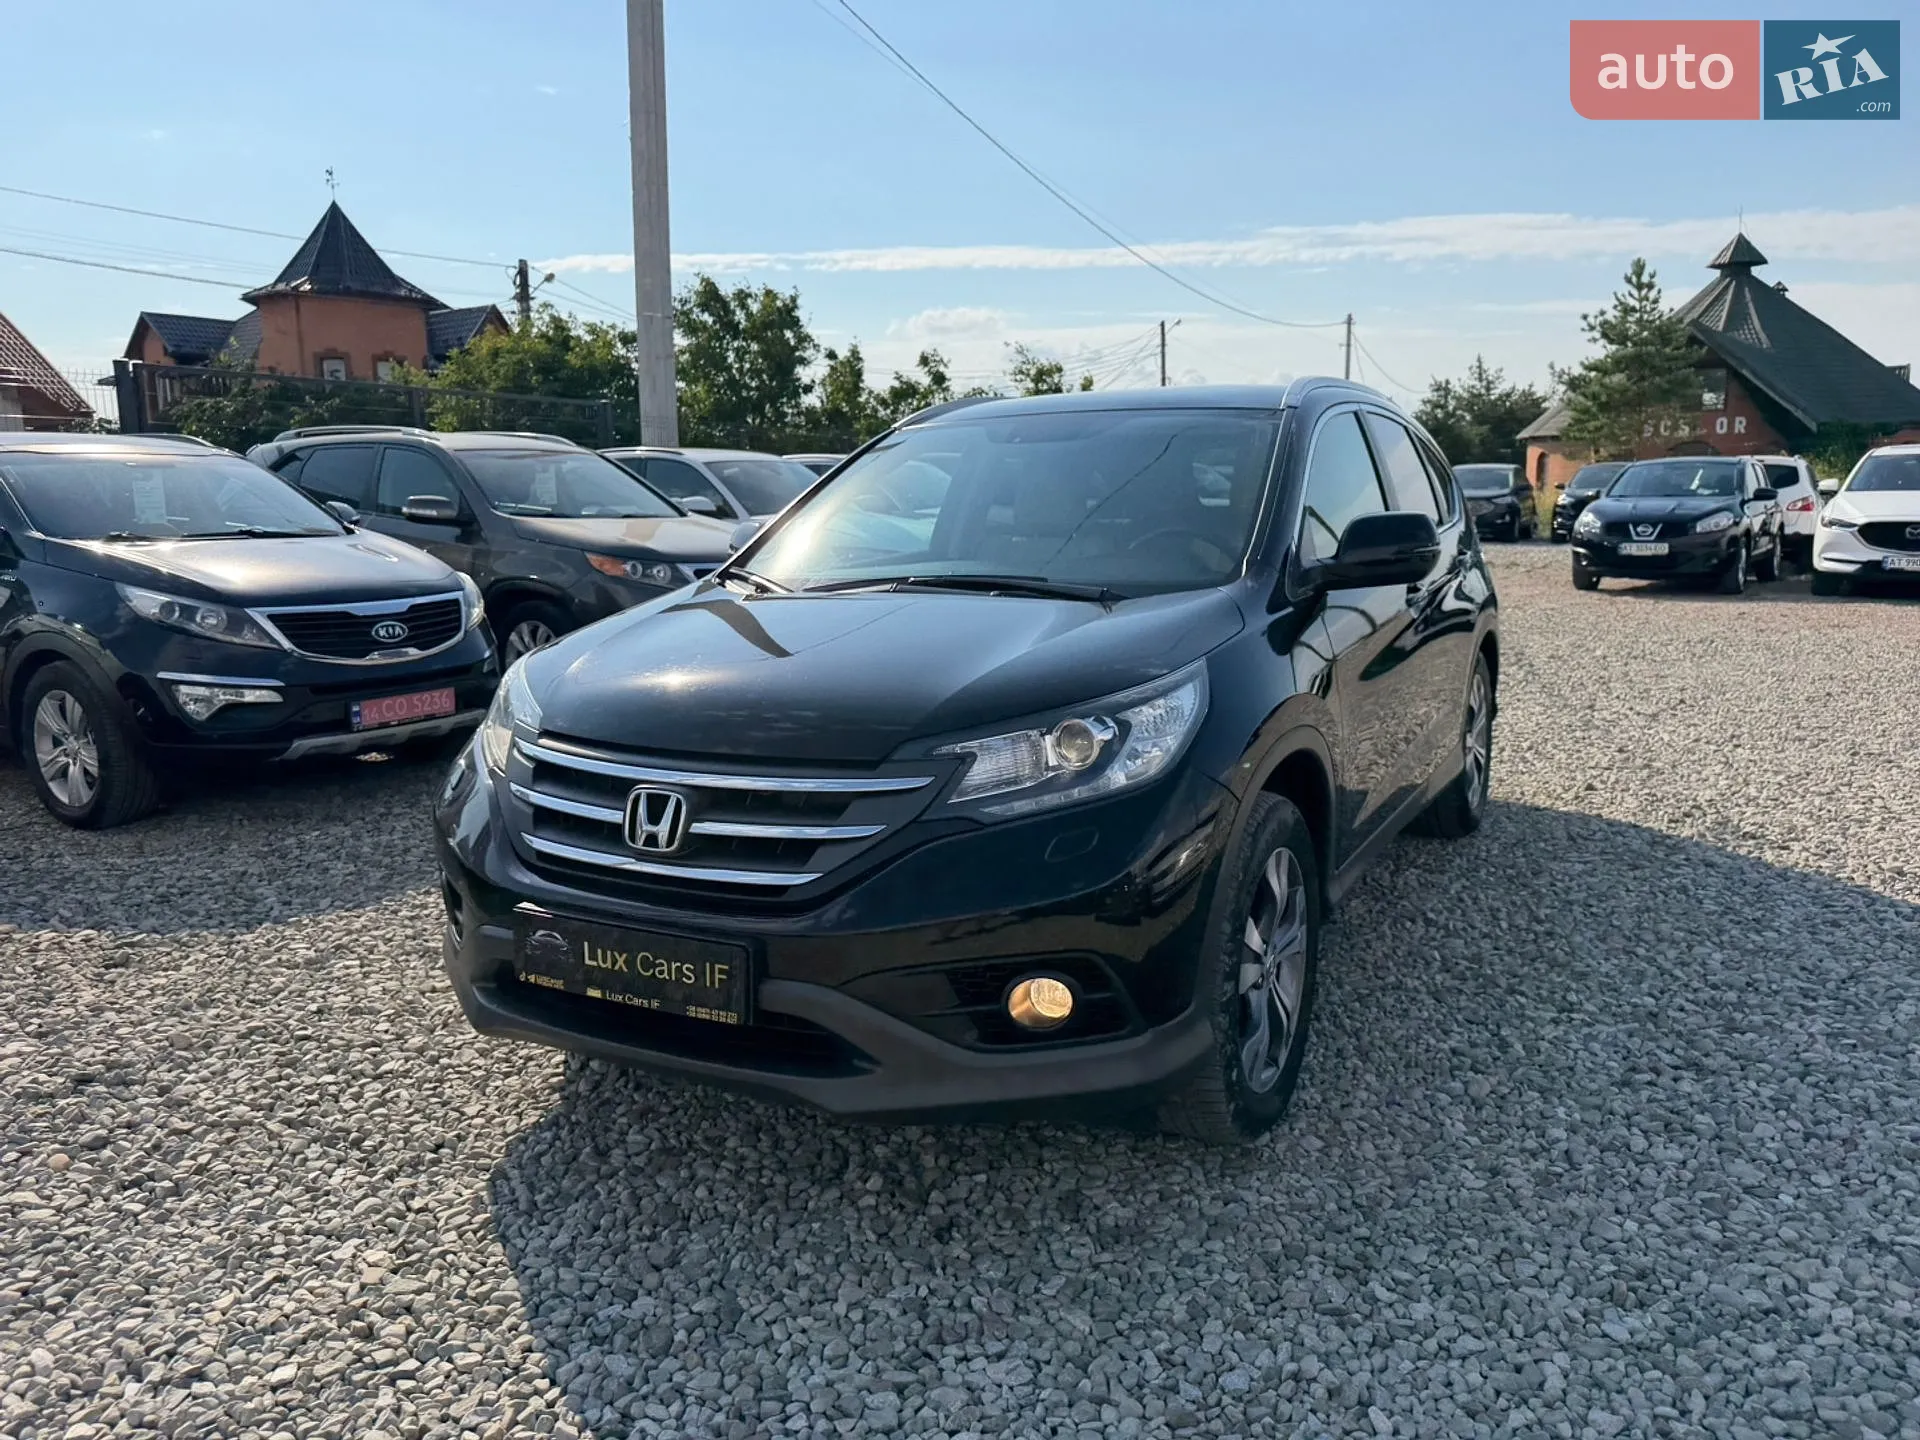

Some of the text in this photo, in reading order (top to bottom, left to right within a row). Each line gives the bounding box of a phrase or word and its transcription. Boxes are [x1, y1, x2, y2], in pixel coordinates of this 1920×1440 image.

[1890, 558, 1903, 567] AT
[379, 625, 403, 637] KIA
[412, 691, 450, 712] 5236
[583, 941, 729, 988] Lux Cars IF
[606, 989, 661, 1009] Lux Cars IF
